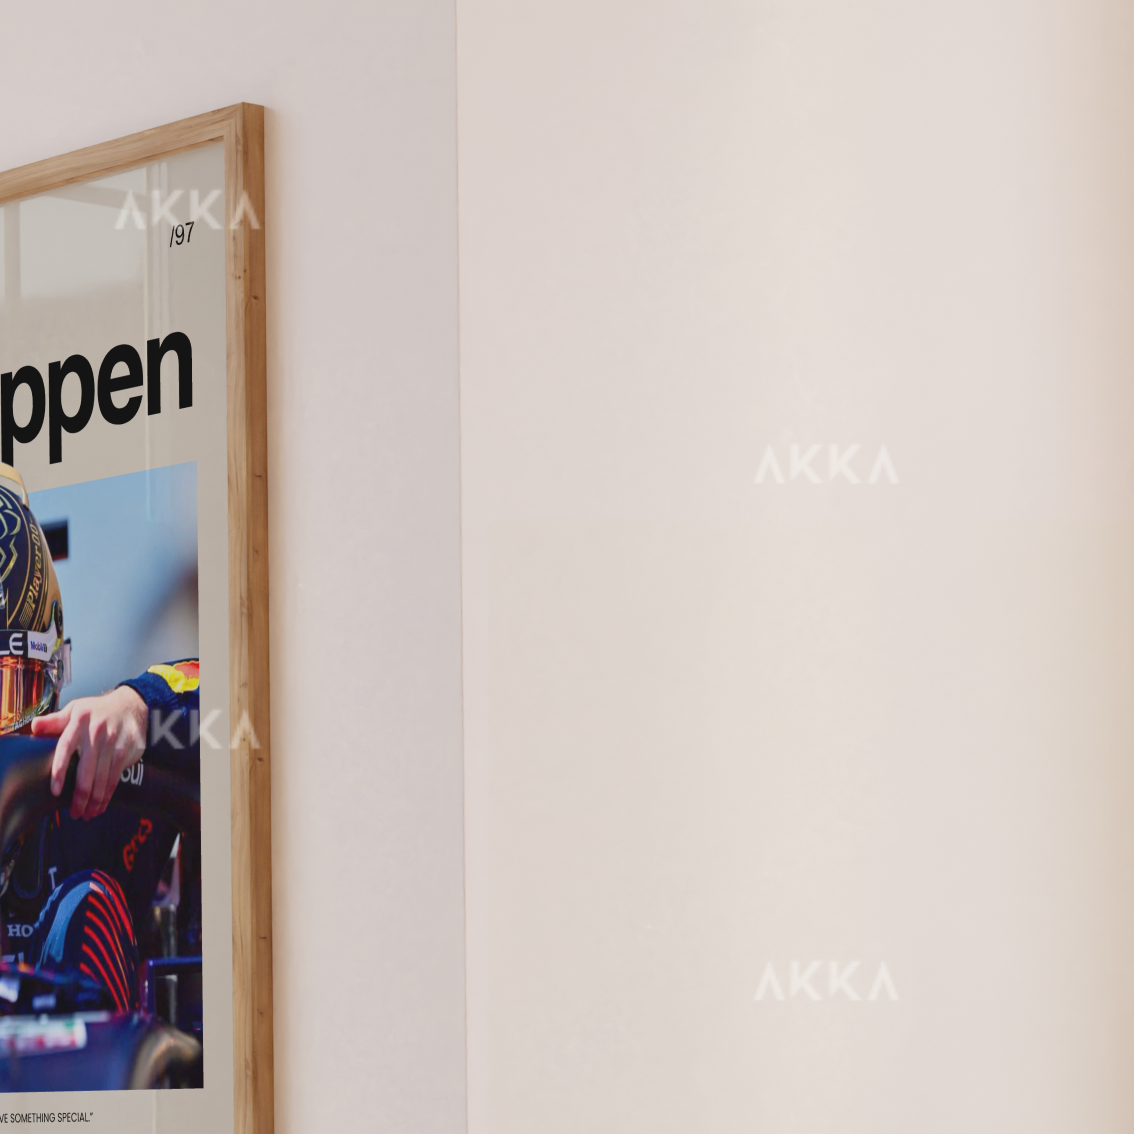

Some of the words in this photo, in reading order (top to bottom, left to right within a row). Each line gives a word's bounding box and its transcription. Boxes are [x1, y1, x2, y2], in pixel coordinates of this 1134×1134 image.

[169, 221, 195, 248] /97
[7, 924, 36, 937] HO
[10, 1113, 56, 1124] SOMETHING
